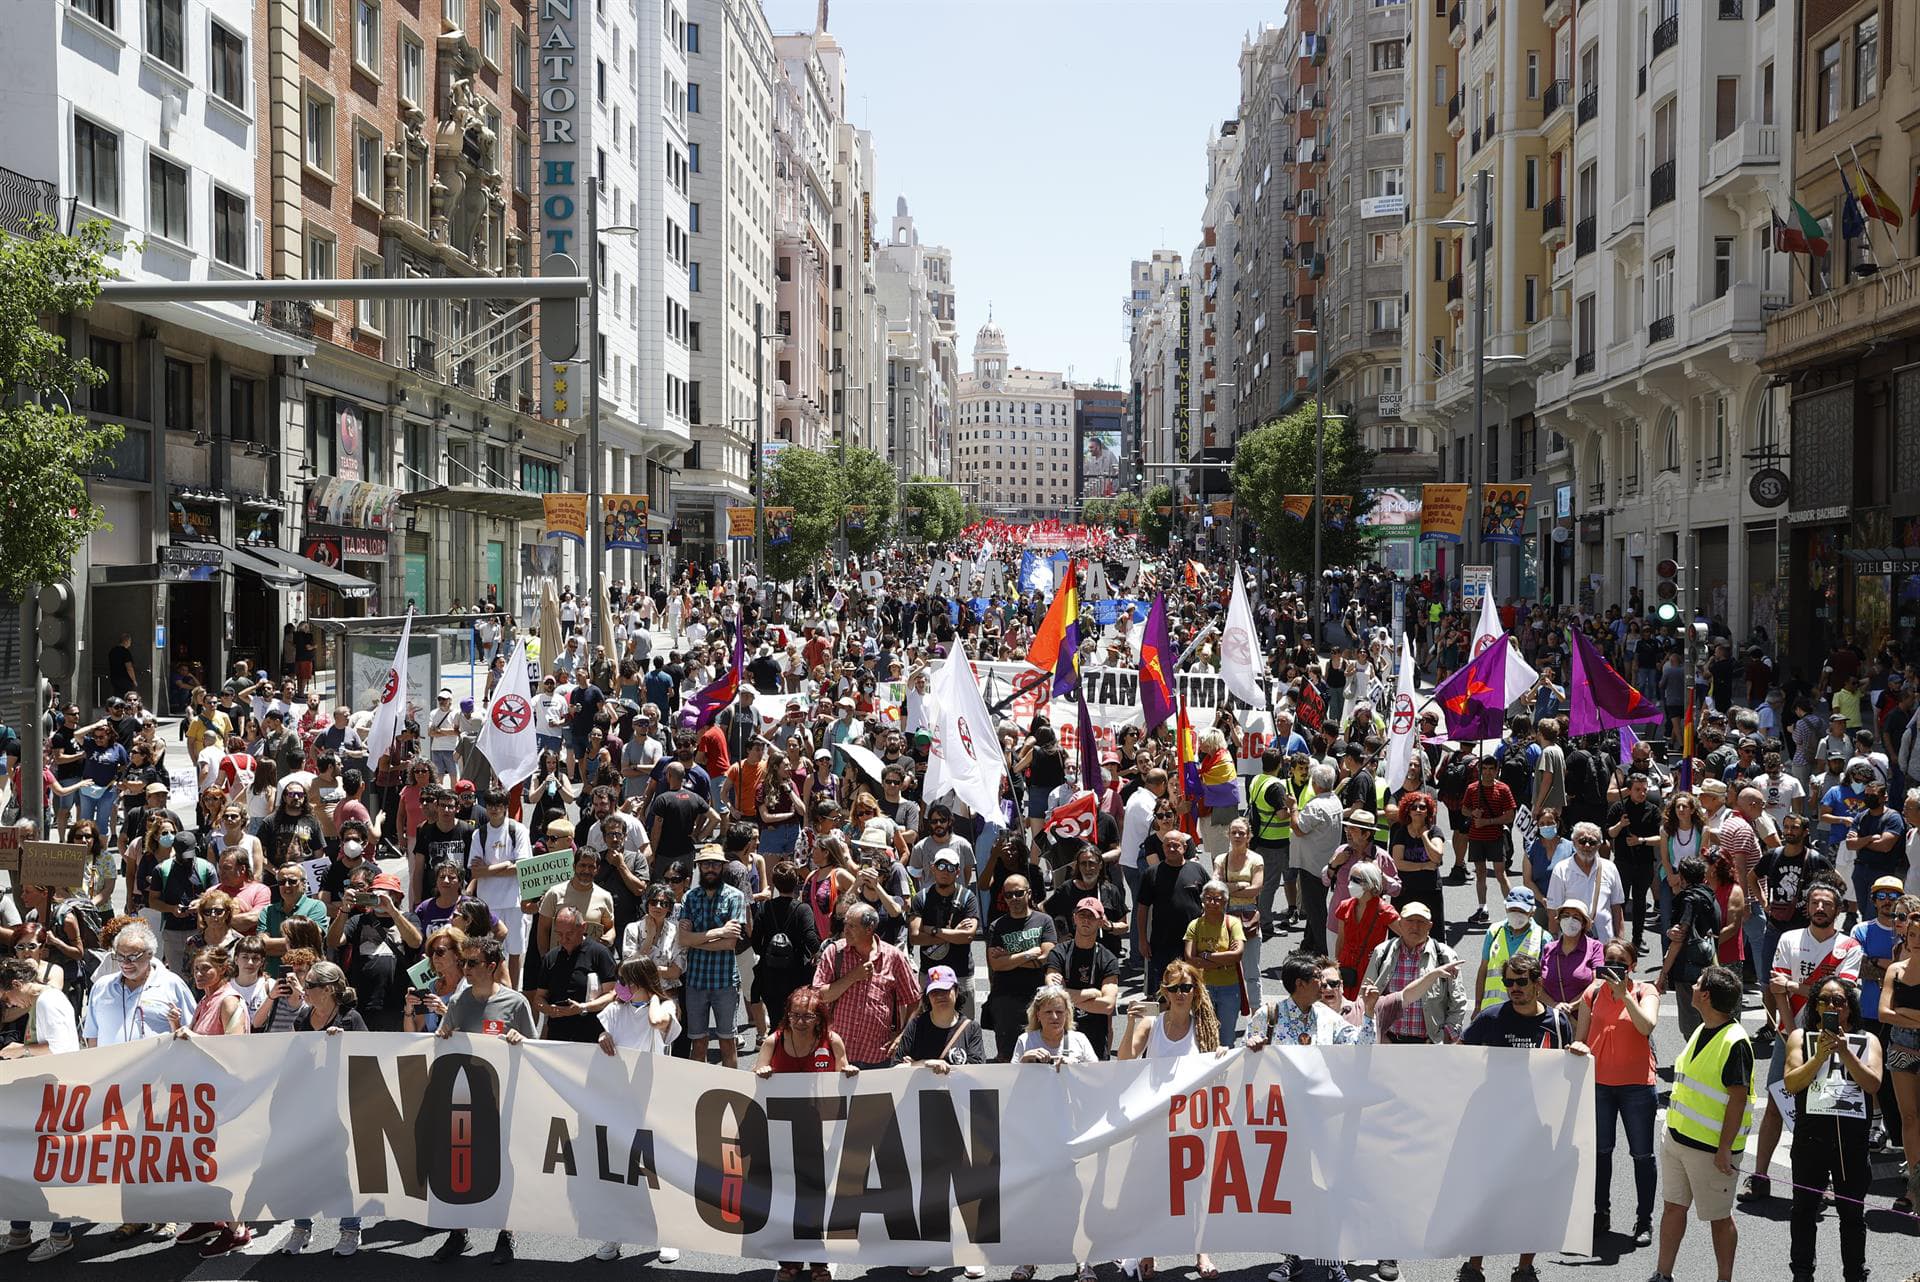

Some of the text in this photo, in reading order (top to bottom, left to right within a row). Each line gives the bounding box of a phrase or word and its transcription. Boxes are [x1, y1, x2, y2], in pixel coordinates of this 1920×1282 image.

[1180, 287, 1190, 350] HOTEL
[1786, 510, 1815, 524] SALVADOR
[356, 538, 368, 554] DEL
[521, 857, 570, 877] DIALOGUE
[522, 871, 572, 890] FOR PEACE
[36, 1083, 217, 1134] NO A LAS
[348, 1053, 501, 1205] NO
[1169, 1083, 1287, 1133] POR LA
[33, 1134, 219, 1185] GUERRAS
[543, 1117, 660, 1190] A LA
[694, 1088, 1001, 1244] OTAN
[1169, 1130, 1293, 1217] PAZ
